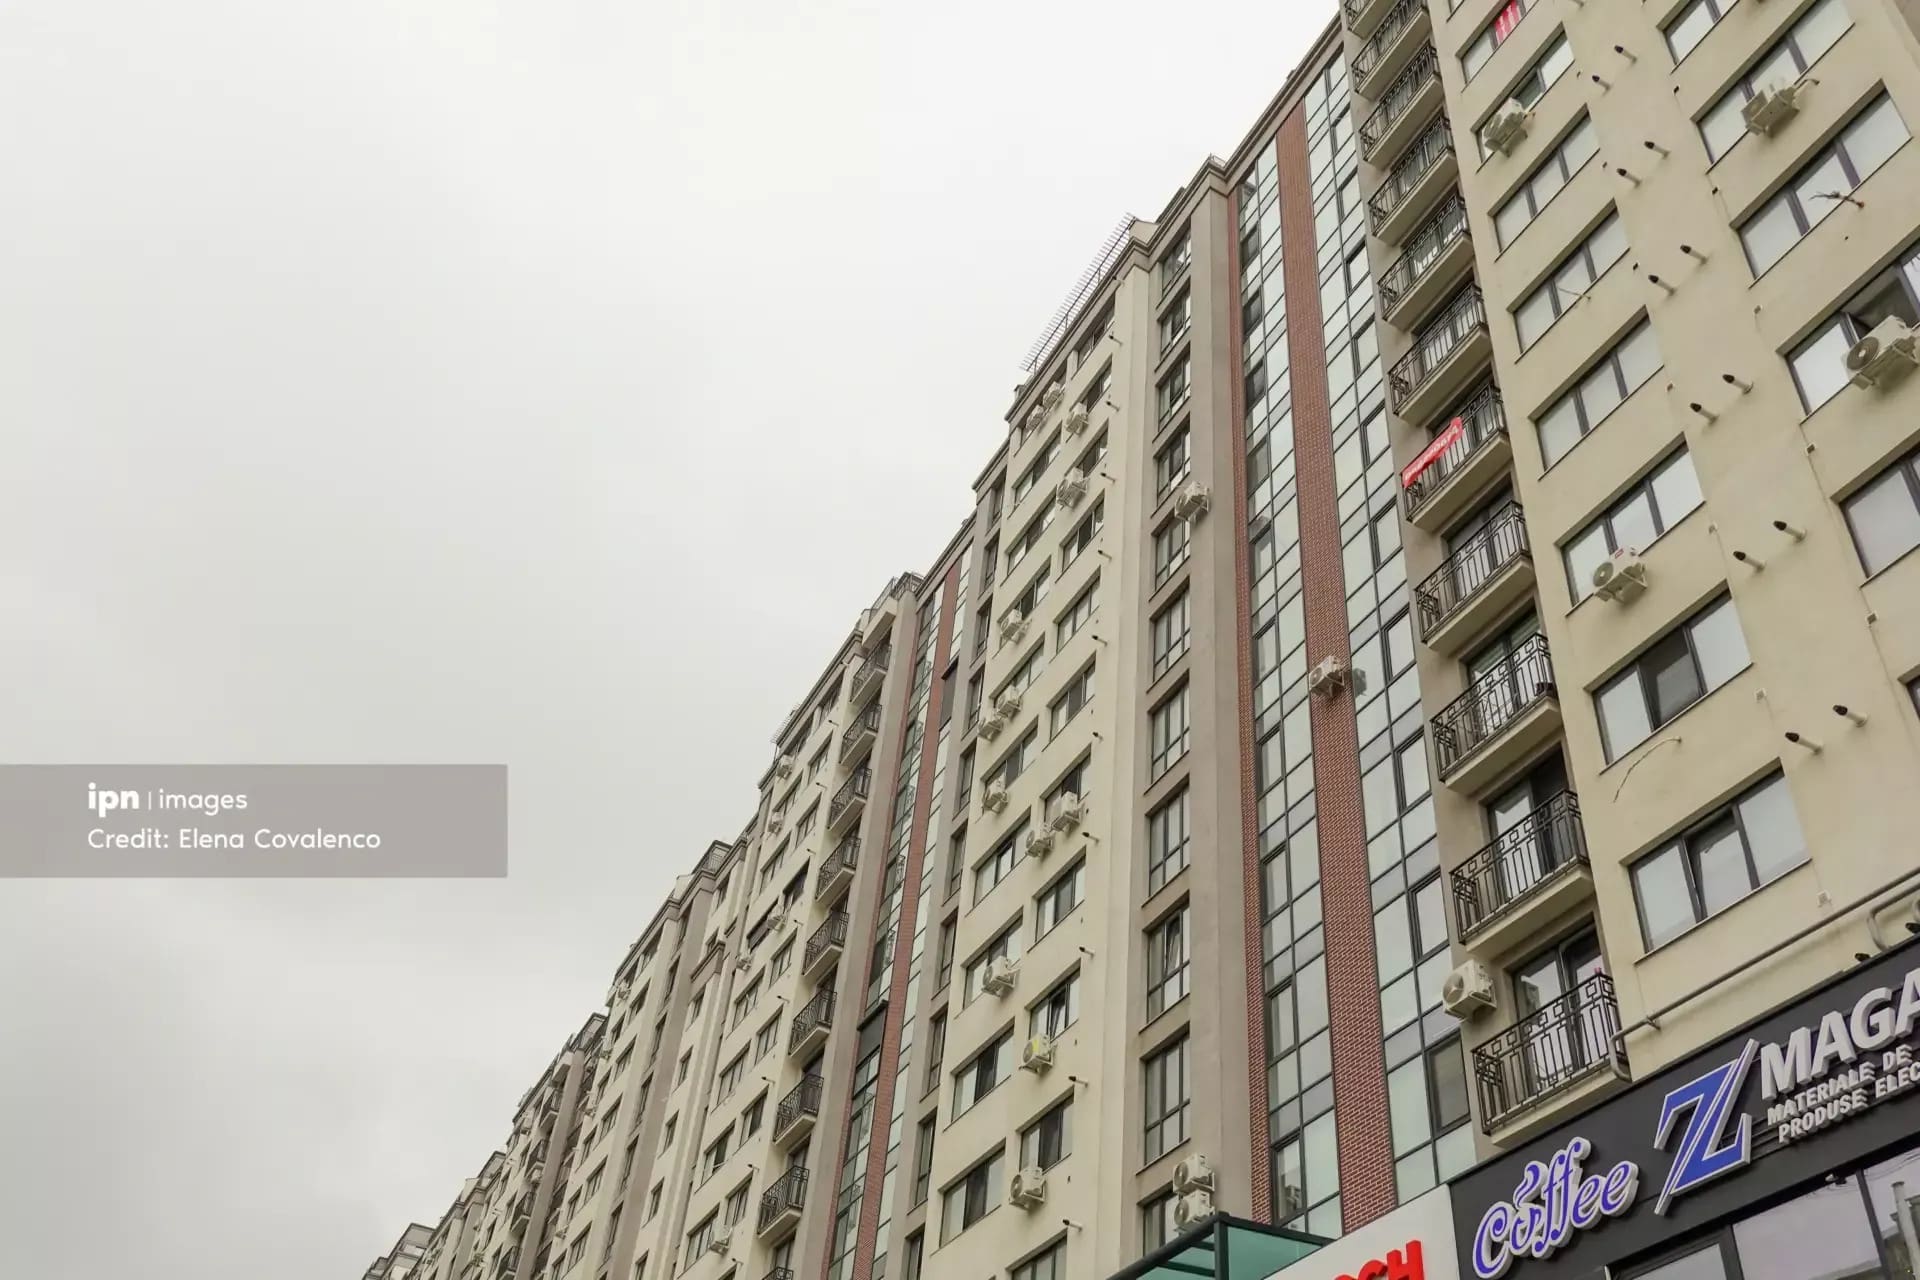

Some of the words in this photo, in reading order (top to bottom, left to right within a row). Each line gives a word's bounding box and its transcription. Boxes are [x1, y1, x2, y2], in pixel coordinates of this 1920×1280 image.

[1767, 1061, 1877, 1127] MATERIALE
[1882, 1044, 1913, 1073] DE
[1778, 1087, 1869, 1145] PRODUSE
[1472, 1136, 1640, 1280] Coffee
